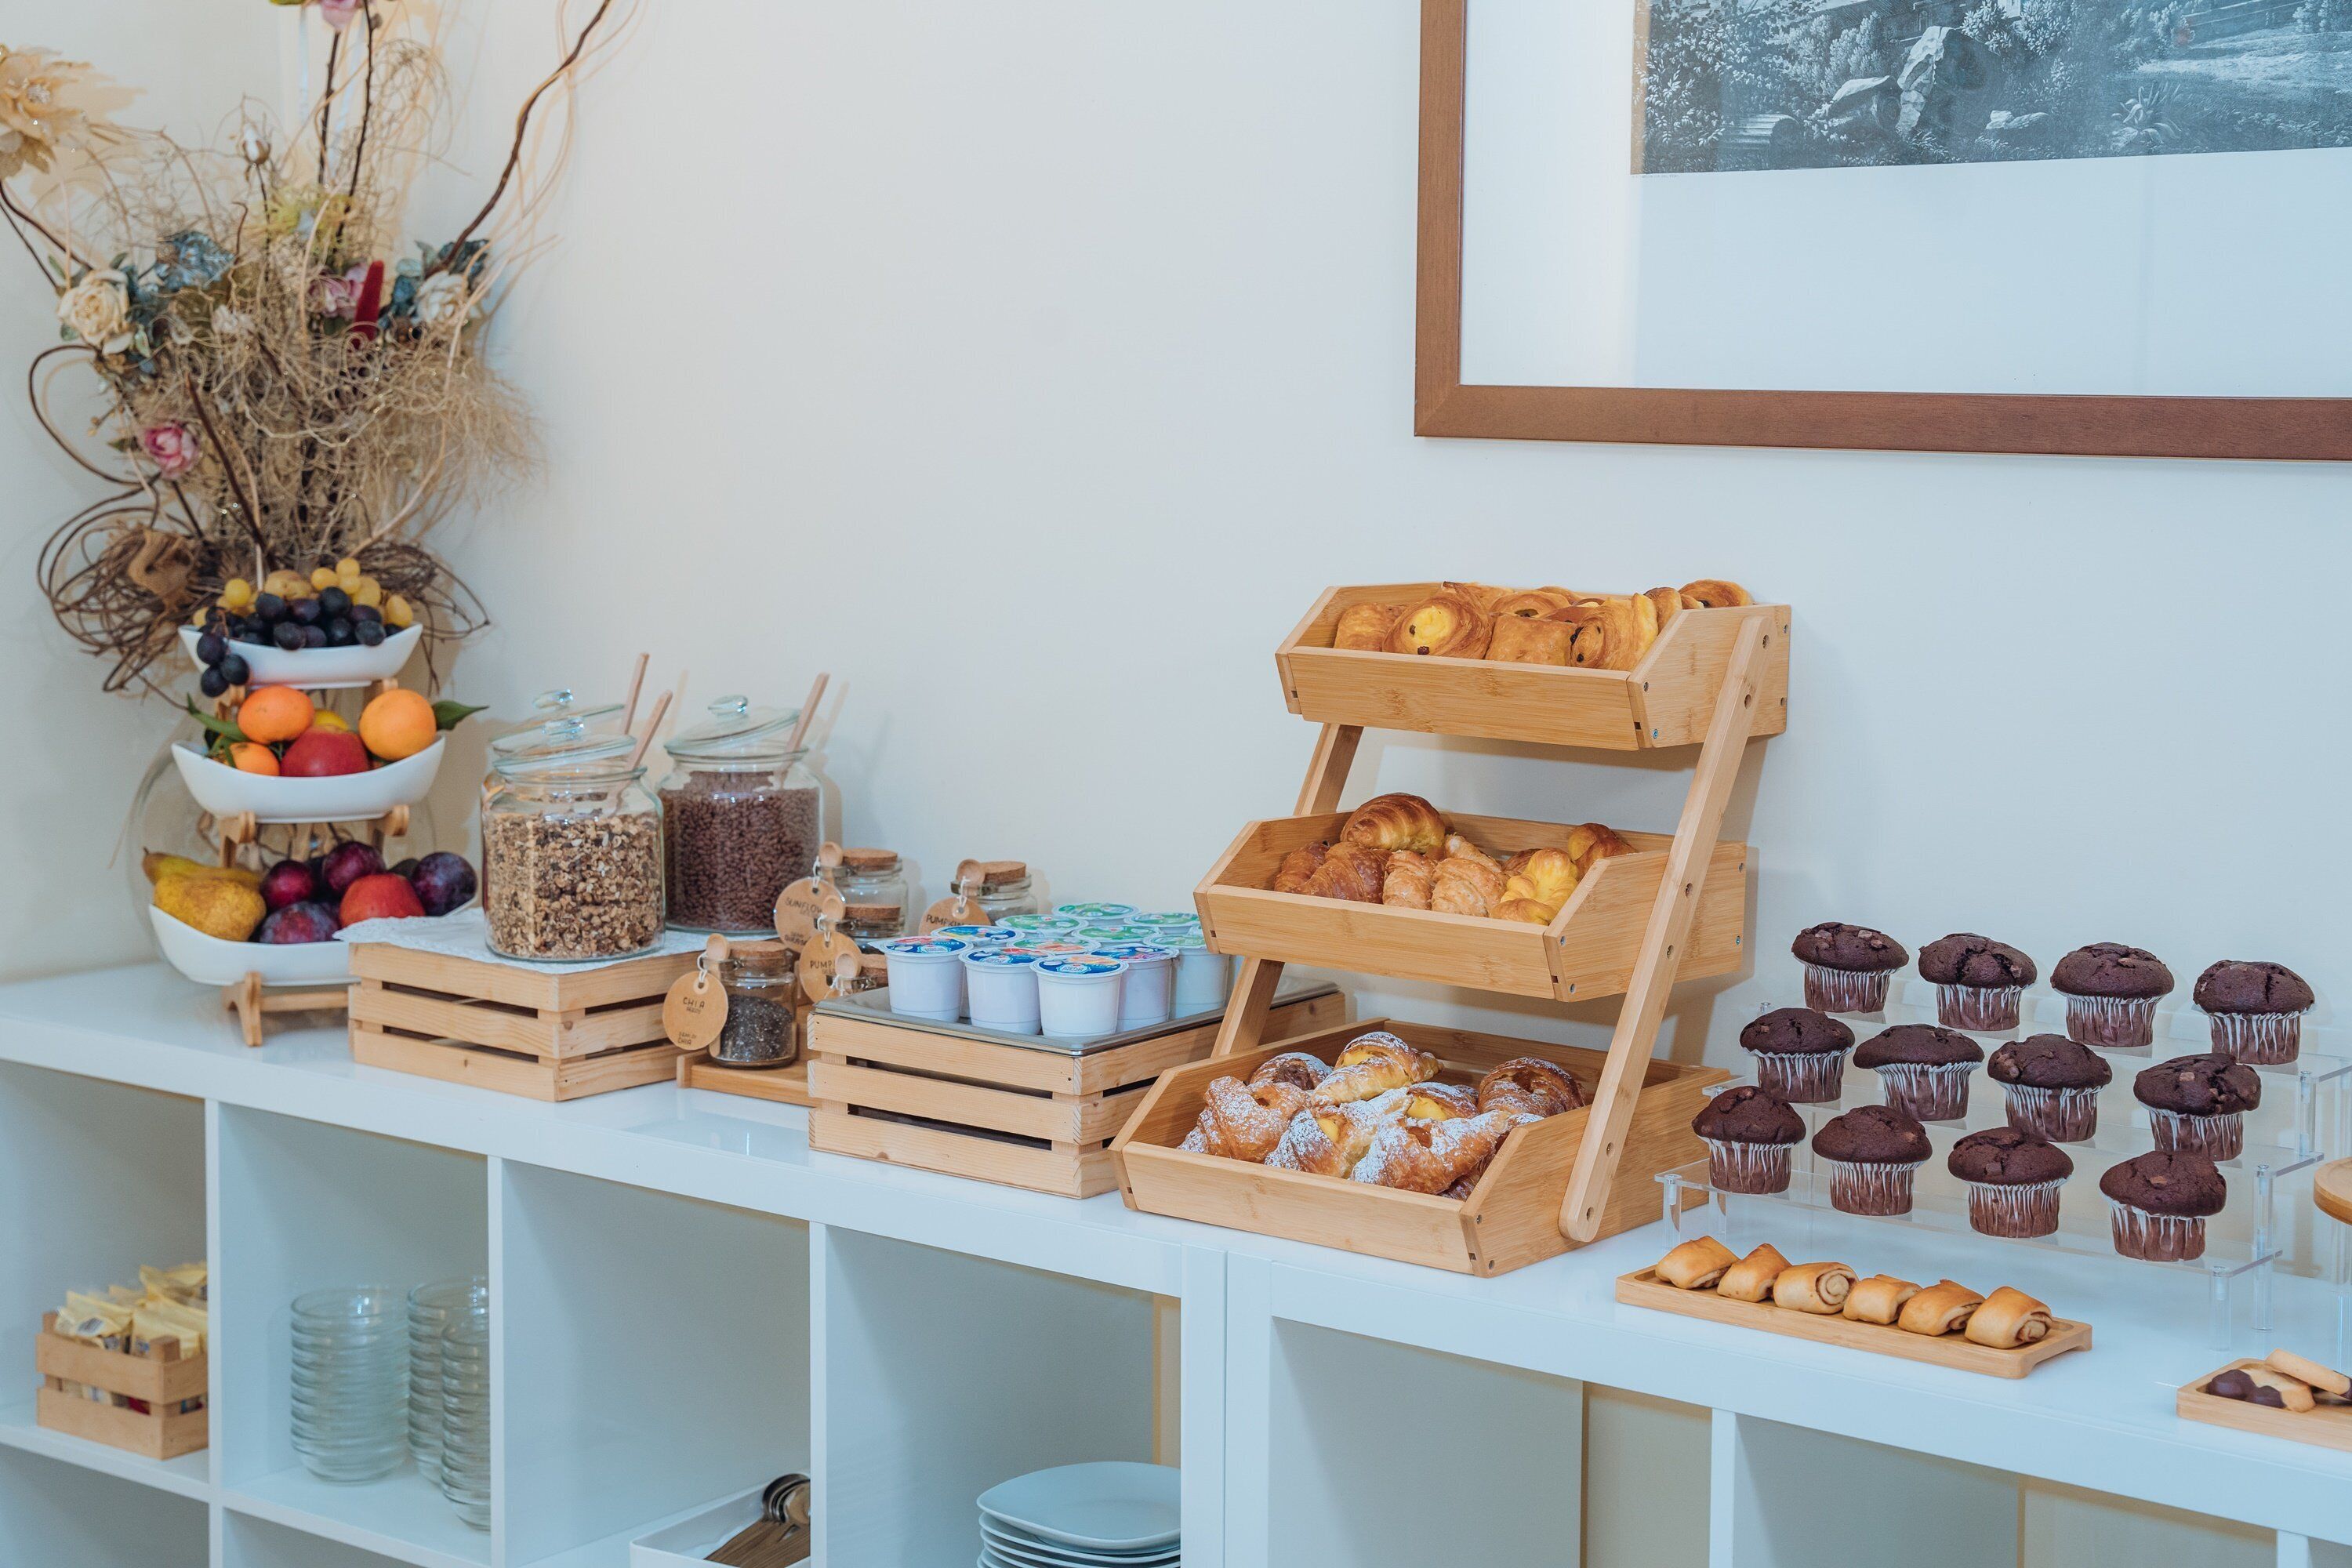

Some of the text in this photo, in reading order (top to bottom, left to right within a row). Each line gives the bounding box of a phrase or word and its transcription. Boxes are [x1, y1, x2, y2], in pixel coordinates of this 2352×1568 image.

[785, 897, 823, 914] SUNFLOW
[810, 960, 836, 970] PUMP
[683, 996, 706, 1009] CHIA
